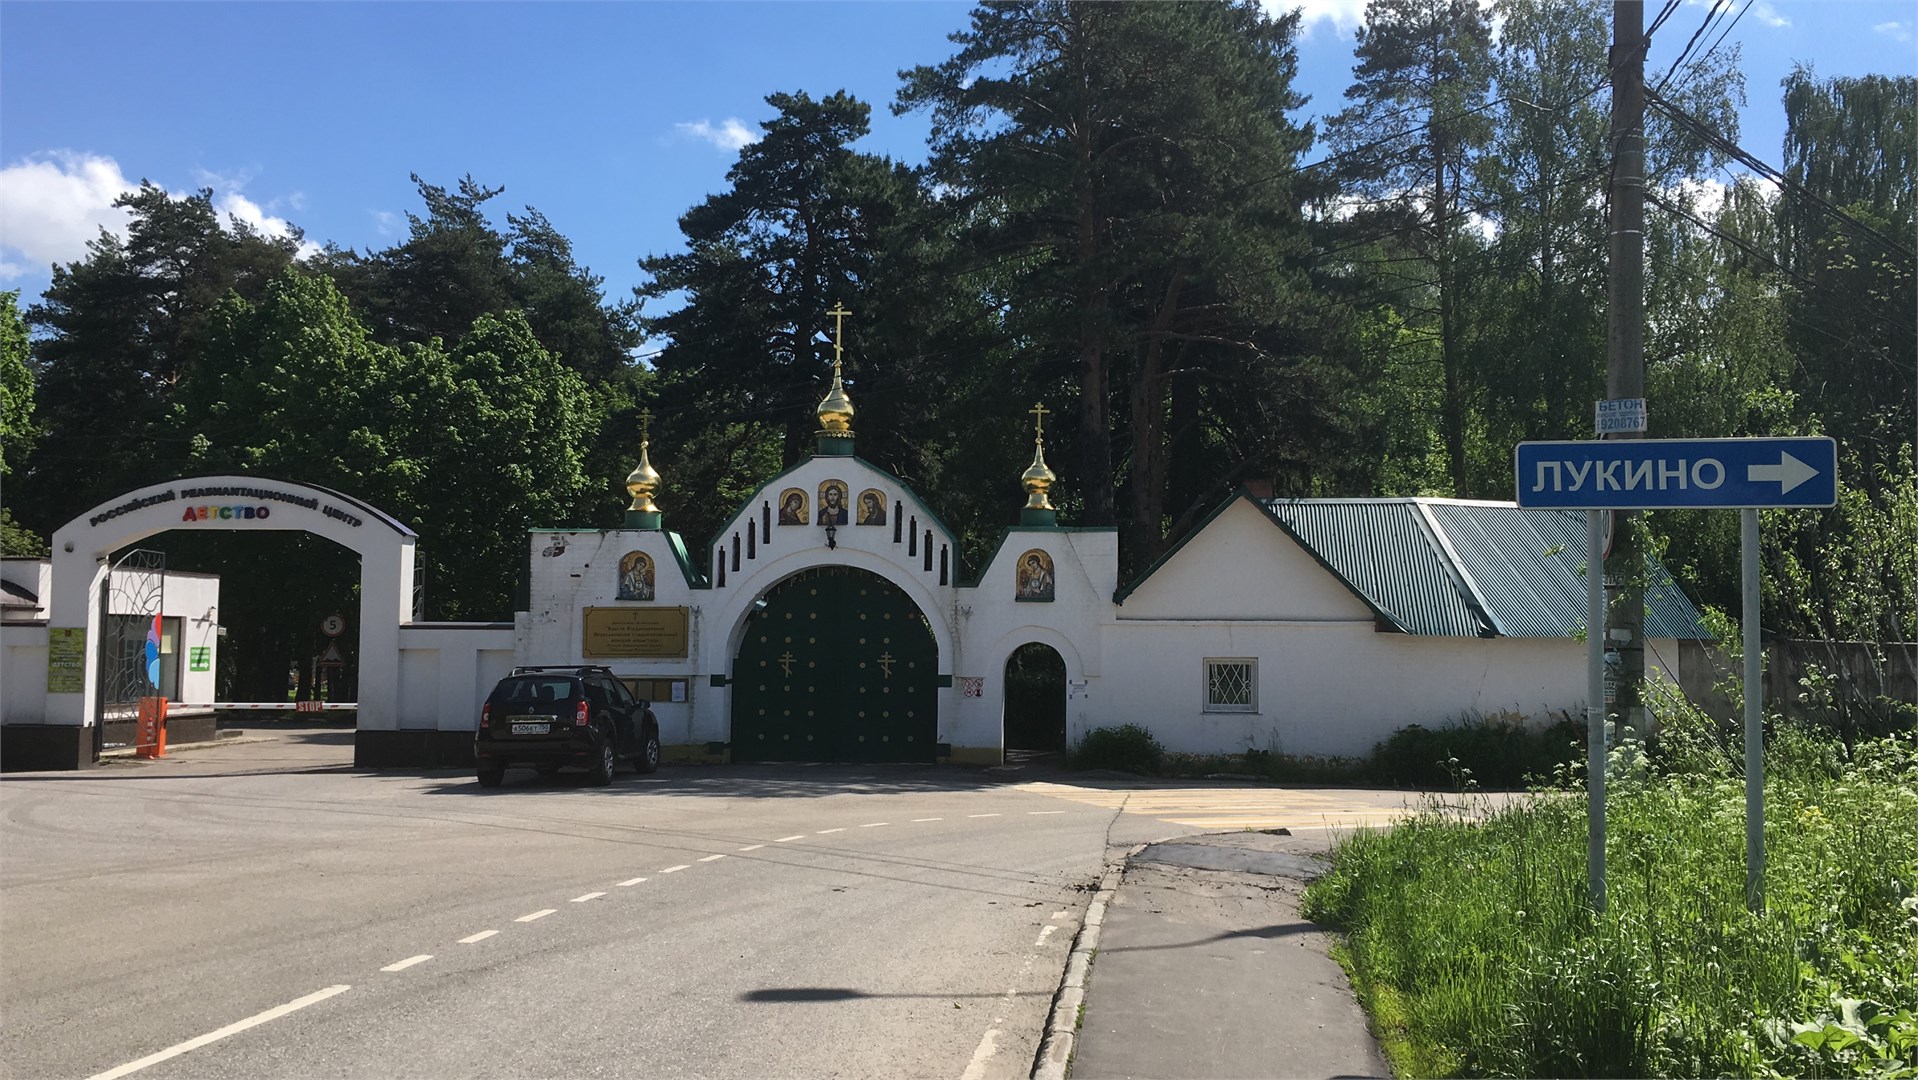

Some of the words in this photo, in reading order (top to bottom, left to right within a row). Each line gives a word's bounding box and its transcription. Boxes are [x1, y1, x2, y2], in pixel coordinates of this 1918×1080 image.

[1599, 400, 1643, 411] БЕТОН
[1601, 416, 1645, 430] 9208767
[1532, 458, 1726, 492] ЛУКИНО
[89, 490, 176, 527] РОССИЙСКИЙ
[322, 504, 363, 527] ЦЕНТР
[182, 506, 270, 522] ДЕТСТВО
[329, 620, 337, 630] 5
[298, 701, 321, 712] STOP
